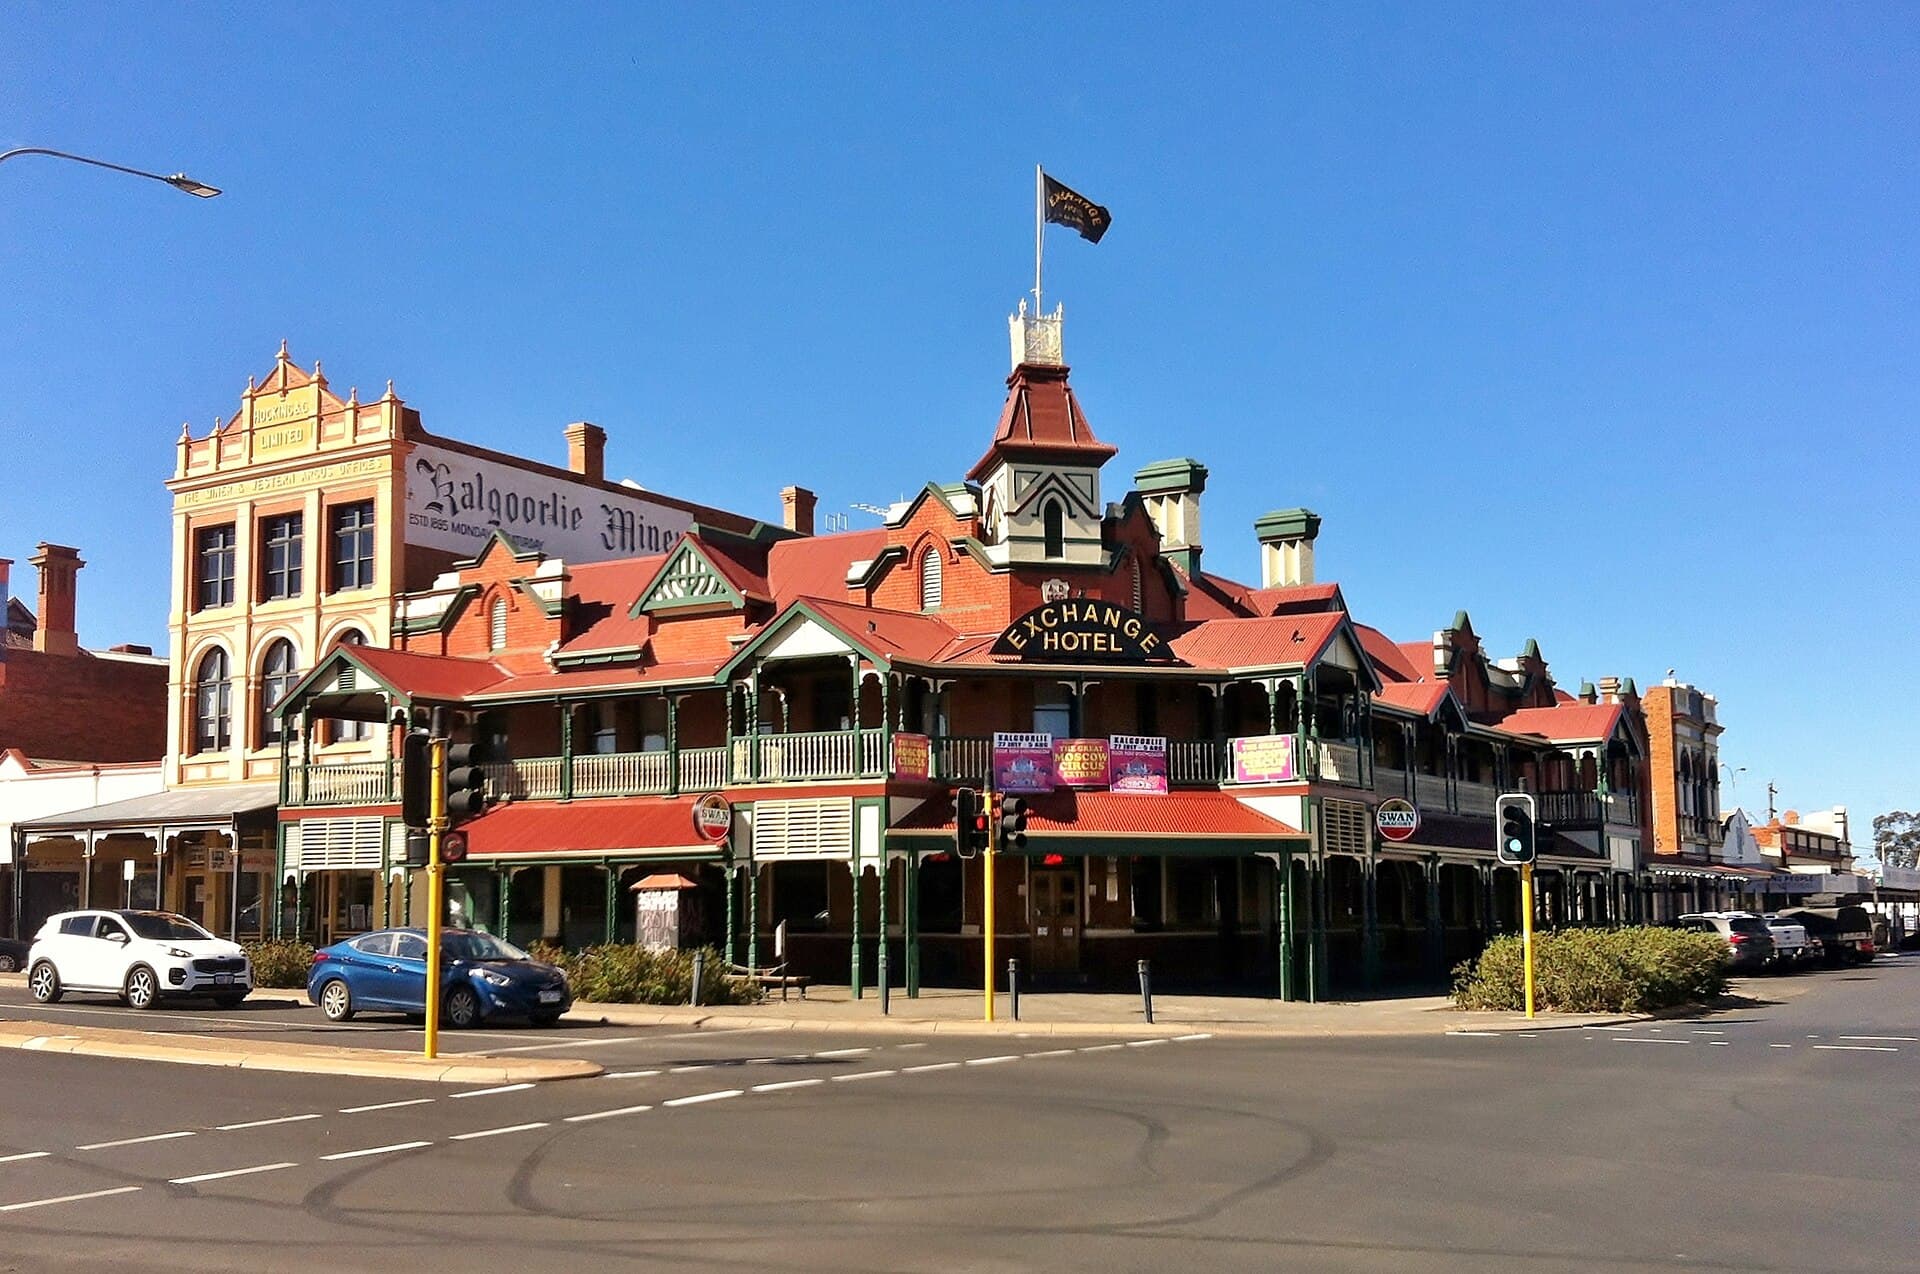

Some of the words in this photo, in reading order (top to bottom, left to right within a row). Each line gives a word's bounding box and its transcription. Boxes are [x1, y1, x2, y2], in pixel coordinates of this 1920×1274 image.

[261, 428, 304, 449] LIMITED
[183, 490, 199, 504] THE
[416, 458, 583, 531] Kalgoorlie
[1007, 603, 1160, 654] EXCHANGE
[1043, 631, 1123, 652] HOTEL
[1114, 736, 1162, 746] KALGOORLIE
[1054, 752, 1108, 762] MOSCOW
[1059, 761, 1105, 771] CIRCUS
[702, 809, 729, 820] SWAN
[1379, 812, 1414, 822] SWAN
